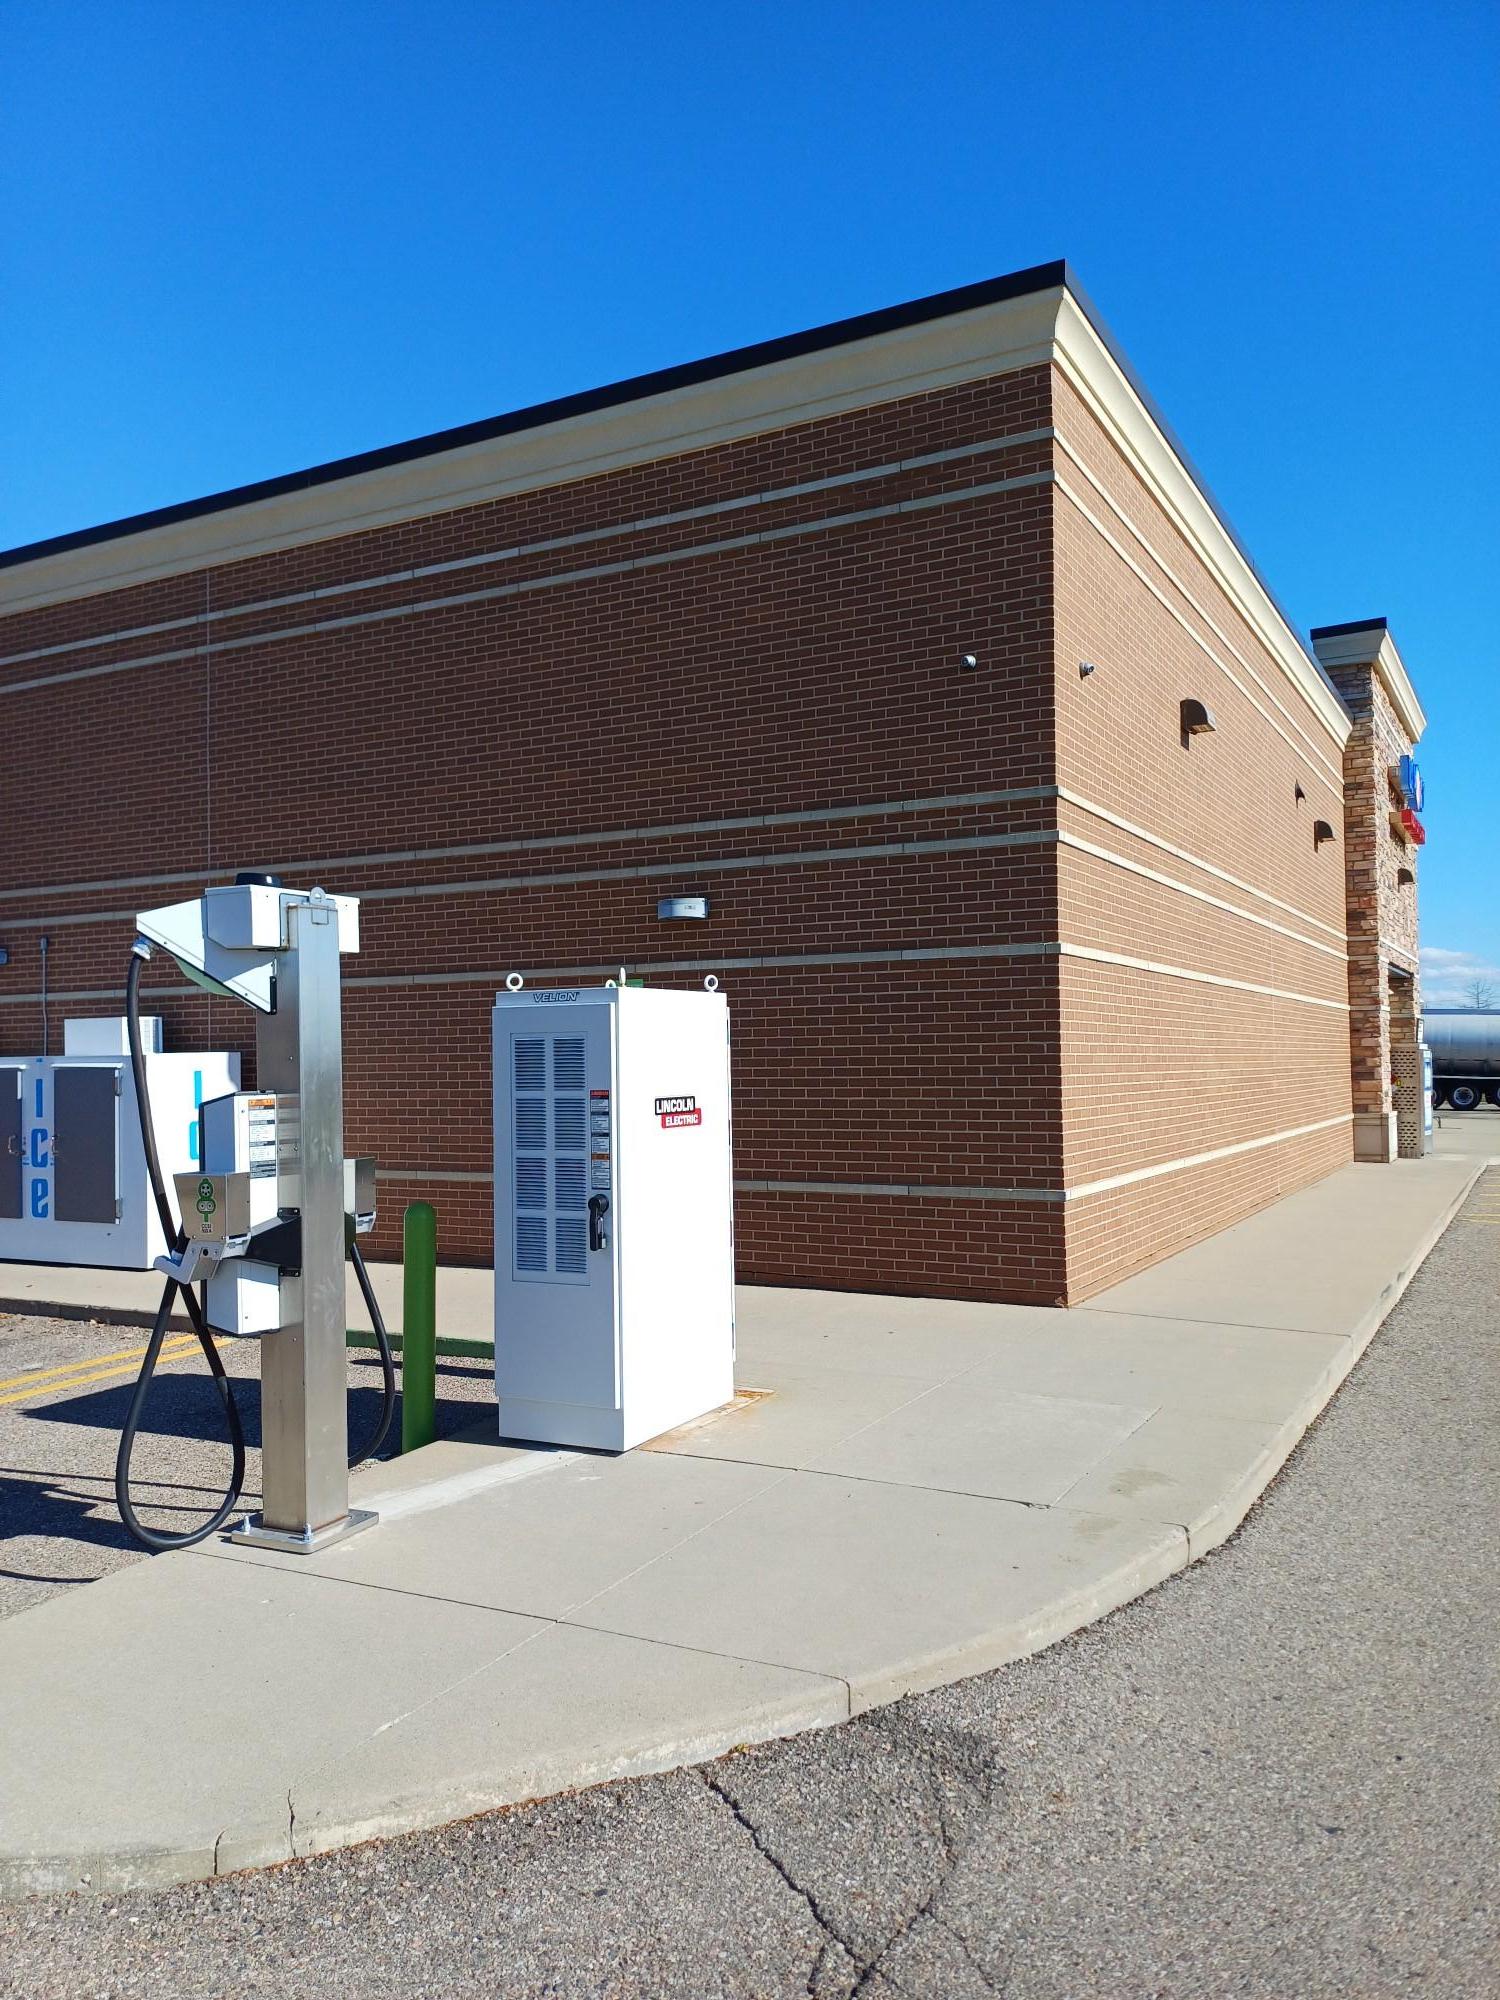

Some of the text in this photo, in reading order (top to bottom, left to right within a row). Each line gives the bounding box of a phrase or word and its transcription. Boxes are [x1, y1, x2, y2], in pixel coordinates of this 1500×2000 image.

[533, 991, 579, 1003] VELION
[656, 1098, 694, 1114] LINCOLN
[665, 1114, 699, 1126] ELECTRIC
